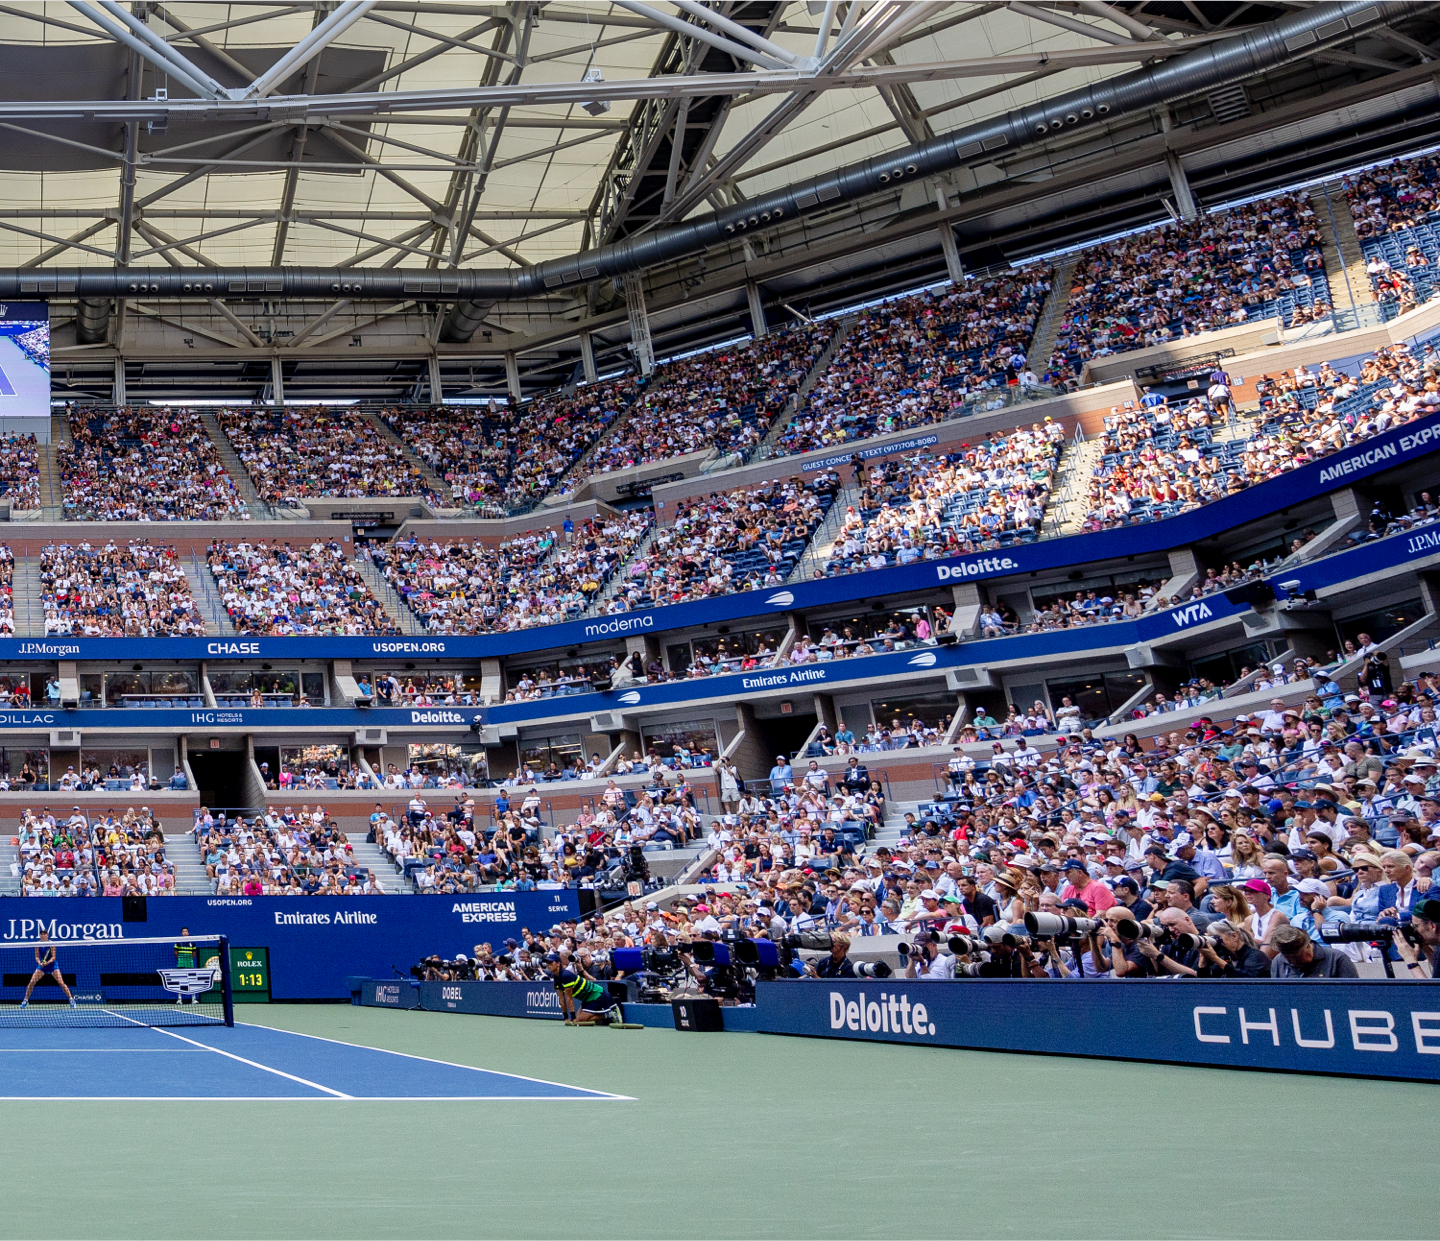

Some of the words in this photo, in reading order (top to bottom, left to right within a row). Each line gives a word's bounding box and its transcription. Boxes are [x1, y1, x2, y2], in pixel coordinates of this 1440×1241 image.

[802, 461, 825, 471] GUEST
[865, 447, 883, 457] TEXT
[1320, 442, 1397, 484] AMERICAN
[1408, 531, 1440, 553] J.P.M
[936, 555, 1019, 581] Deloitte.
[1171, 602, 1212, 627] WTA
[585, 615, 654, 636] moderna
[18, 643, 80, 656] J.P.Morgan
[207, 643, 260, 654] CHASE
[372, 643, 445, 652] USOPEN.ORG
[742, 672, 788, 690] Emirates
[789, 668, 826, 683] Airline
[191, 713, 215, 723] IHG
[411, 711, 466, 723] Deloitte.
[452, 902, 515, 913] AMERICAN
[274, 912, 330, 925] Emirates
[334, 911, 378, 924] Airline
[462, 912, 517, 923] EXPRESS
[3, 919, 124, 941] J.P.Morgan
[237, 960, 262, 968] ROLEX
[239, 974, 262, 986] 1:13
[442, 986, 462, 1000] DOBEL
[830, 992, 936, 1036] Deloitte.
